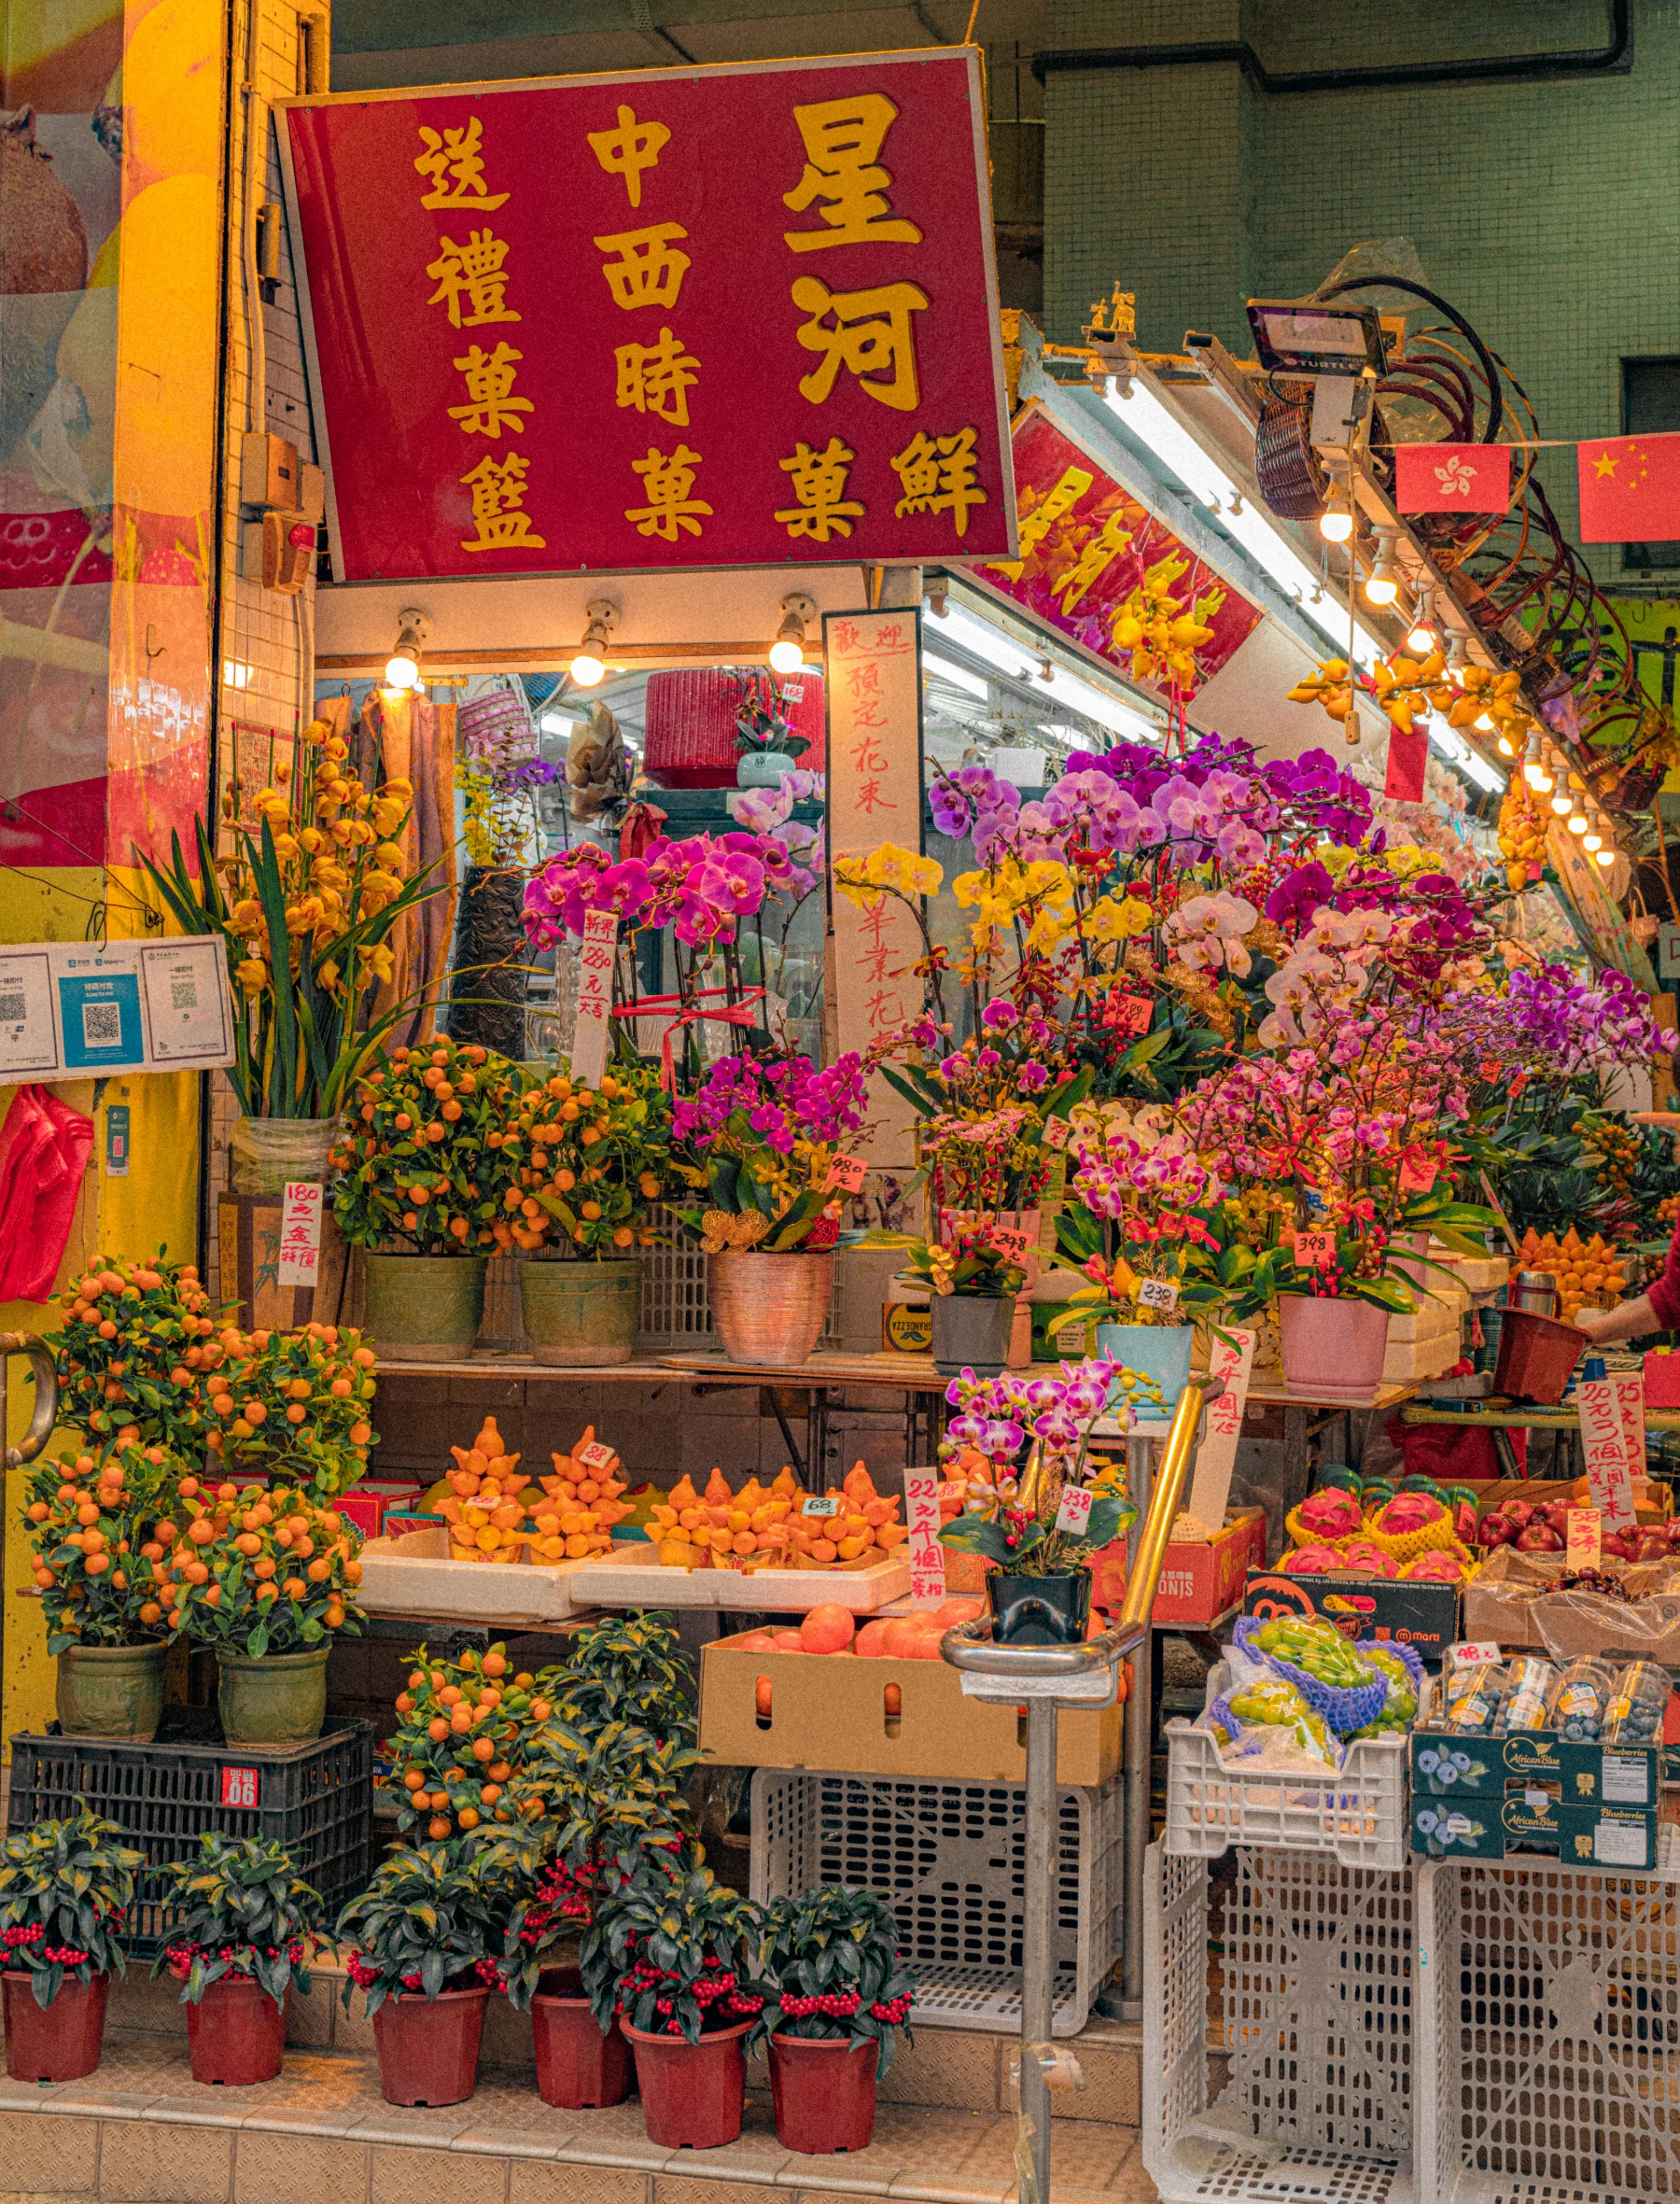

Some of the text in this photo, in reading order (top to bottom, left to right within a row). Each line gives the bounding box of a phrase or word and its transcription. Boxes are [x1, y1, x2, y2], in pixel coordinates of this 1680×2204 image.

[782, 92, 929, 412] 星河
[587, 104, 714, 542] 中西時菓
[413, 116, 547, 552] 送禮菓籃
[1298, 360, 1361, 371] TURTLE
[775, 426, 987, 543] 鮮菓
[832, 620, 911, 653] 歡迎
[846, 662, 898, 815] 預定花束
[579, 1003, 603, 1019] 大吉
[833, 1158, 862, 1173] 480
[995, 1232, 1026, 1252] 248
[1298, 1235, 1326, 1252] 398
[892, 1321, 932, 1331] GRANDEZZA
[586, 1445, 607, 1462] 88
[938, 1482, 959, 1498] 88
[807, 1499, 831, 1509] 68
[1063, 1490, 1091, 1511] 238
[1509, 1754, 1561, 1765] African Blue
[1603, 1746, 1647, 1757] Blueberries
[229, 1782, 255, 1805] 06
[1507, 1815, 1559, 1828] African Blue
[1600, 1807, 1645, 1819] Blueberries
